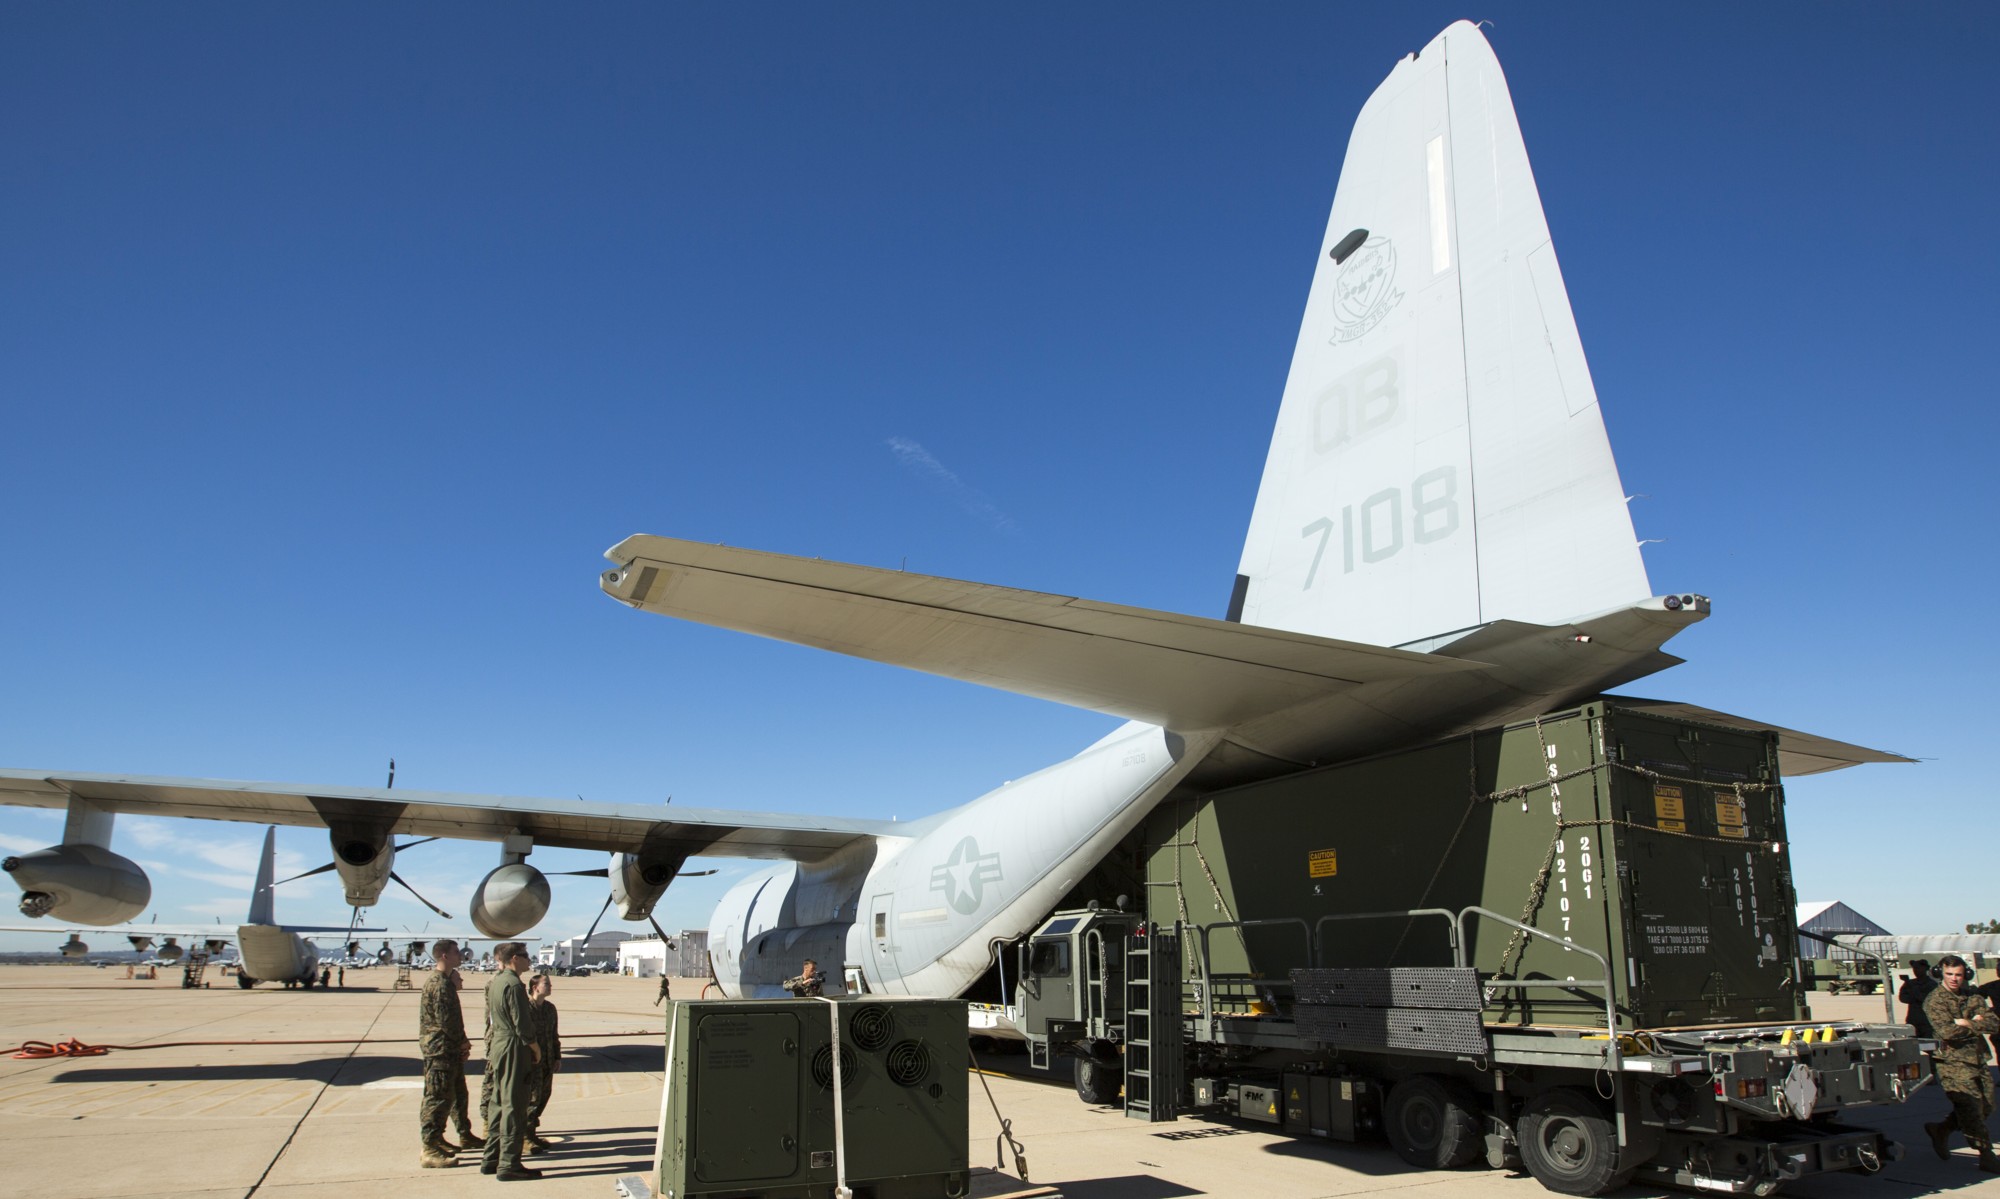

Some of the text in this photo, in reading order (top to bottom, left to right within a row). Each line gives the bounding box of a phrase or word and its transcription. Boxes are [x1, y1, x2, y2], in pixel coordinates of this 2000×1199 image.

[1313, 355, 1400, 457] QB
[1301, 465, 1460, 592] 7108
[1656, 787, 1681, 797] CAUTION
[1739, 796, 1749, 838] SAU
[1310, 851, 1335, 861] CAUTION
[1580, 836, 1592, 899] 20G1
[1733, 868, 1744, 927] 20G1
[1746, 852, 1760, 938] 021078
[1647, 936, 1660, 944] TARE
[1757, 953, 1764, 968] 2
[1245, 1090, 1264, 1103] FMC
